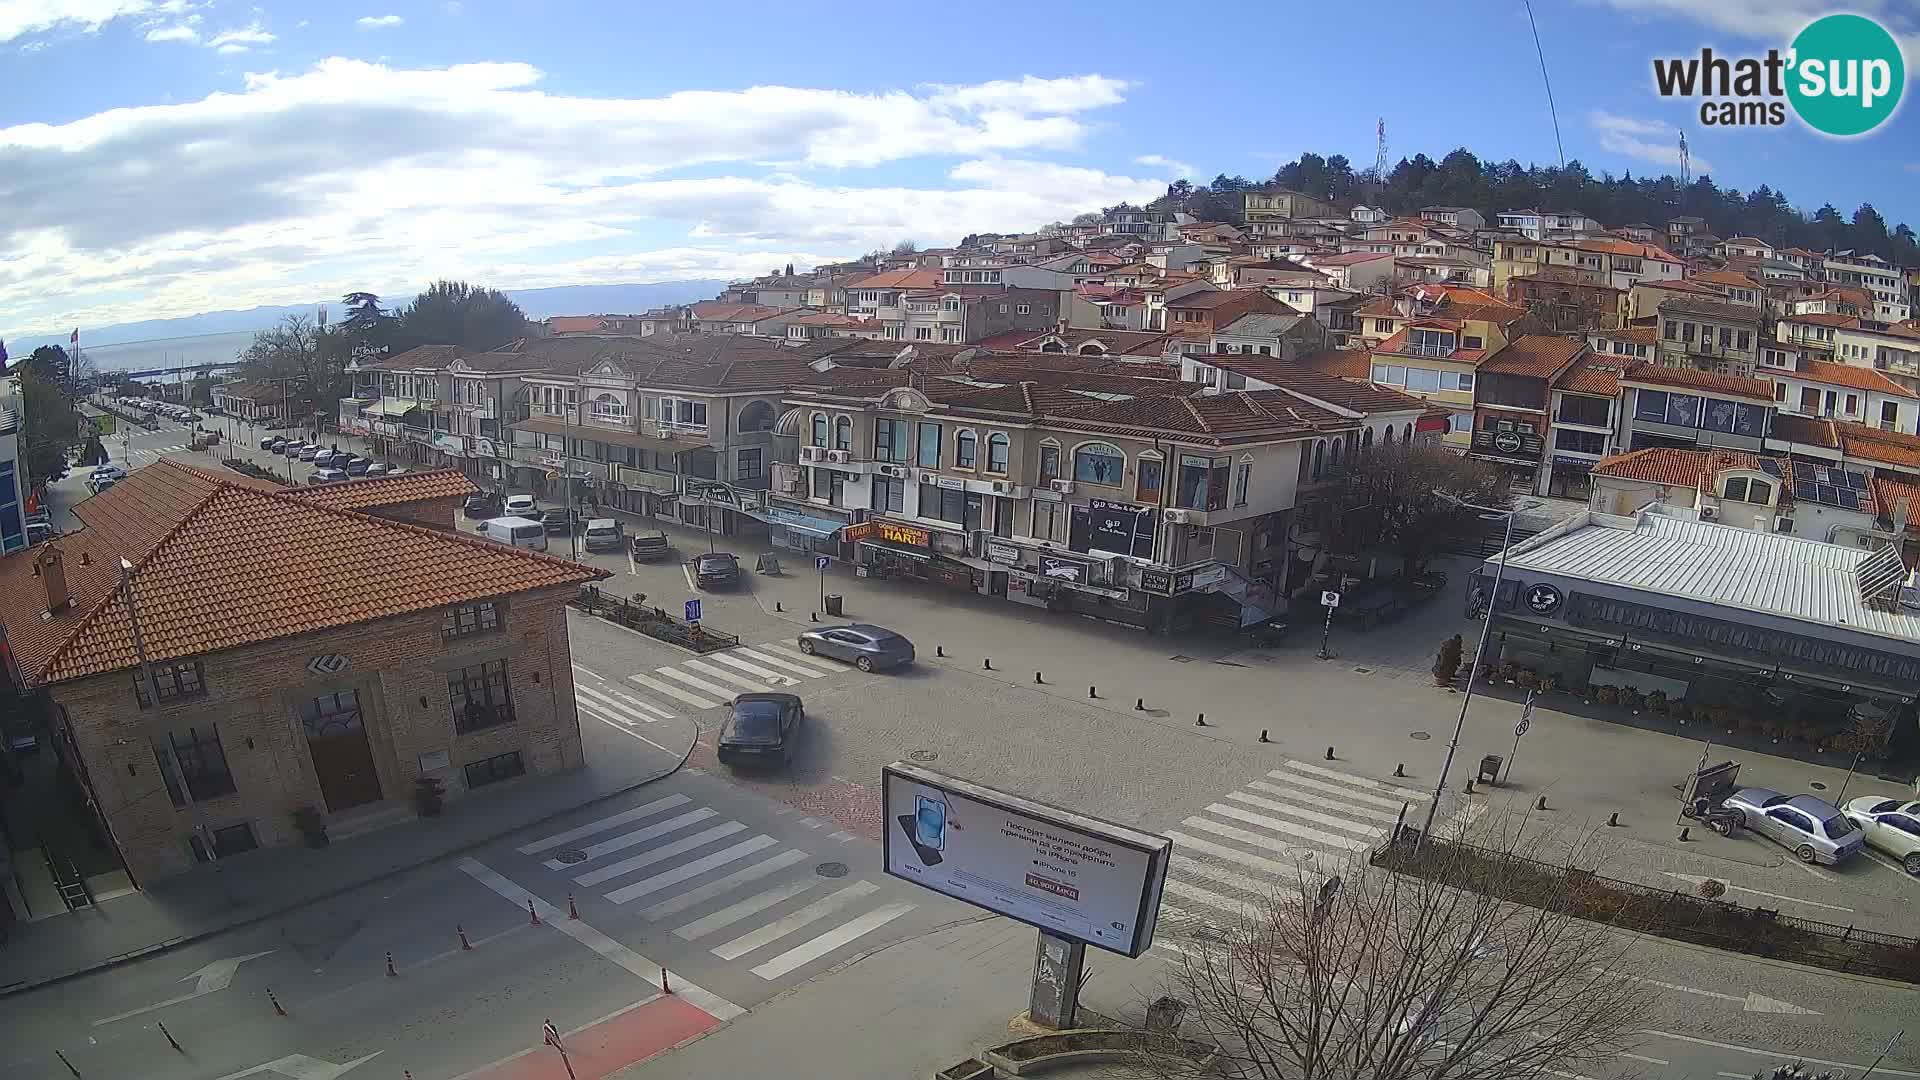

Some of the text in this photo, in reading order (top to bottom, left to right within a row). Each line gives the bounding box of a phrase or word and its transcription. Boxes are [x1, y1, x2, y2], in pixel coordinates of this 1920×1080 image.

[819, 559, 826, 569] P
[1000, 828, 1038, 844] причини
[1039, 840, 1051, 849] да
[1005, 820, 1112, 859] Постојат милион добри
[1039, 861, 1067, 874] iPhone
